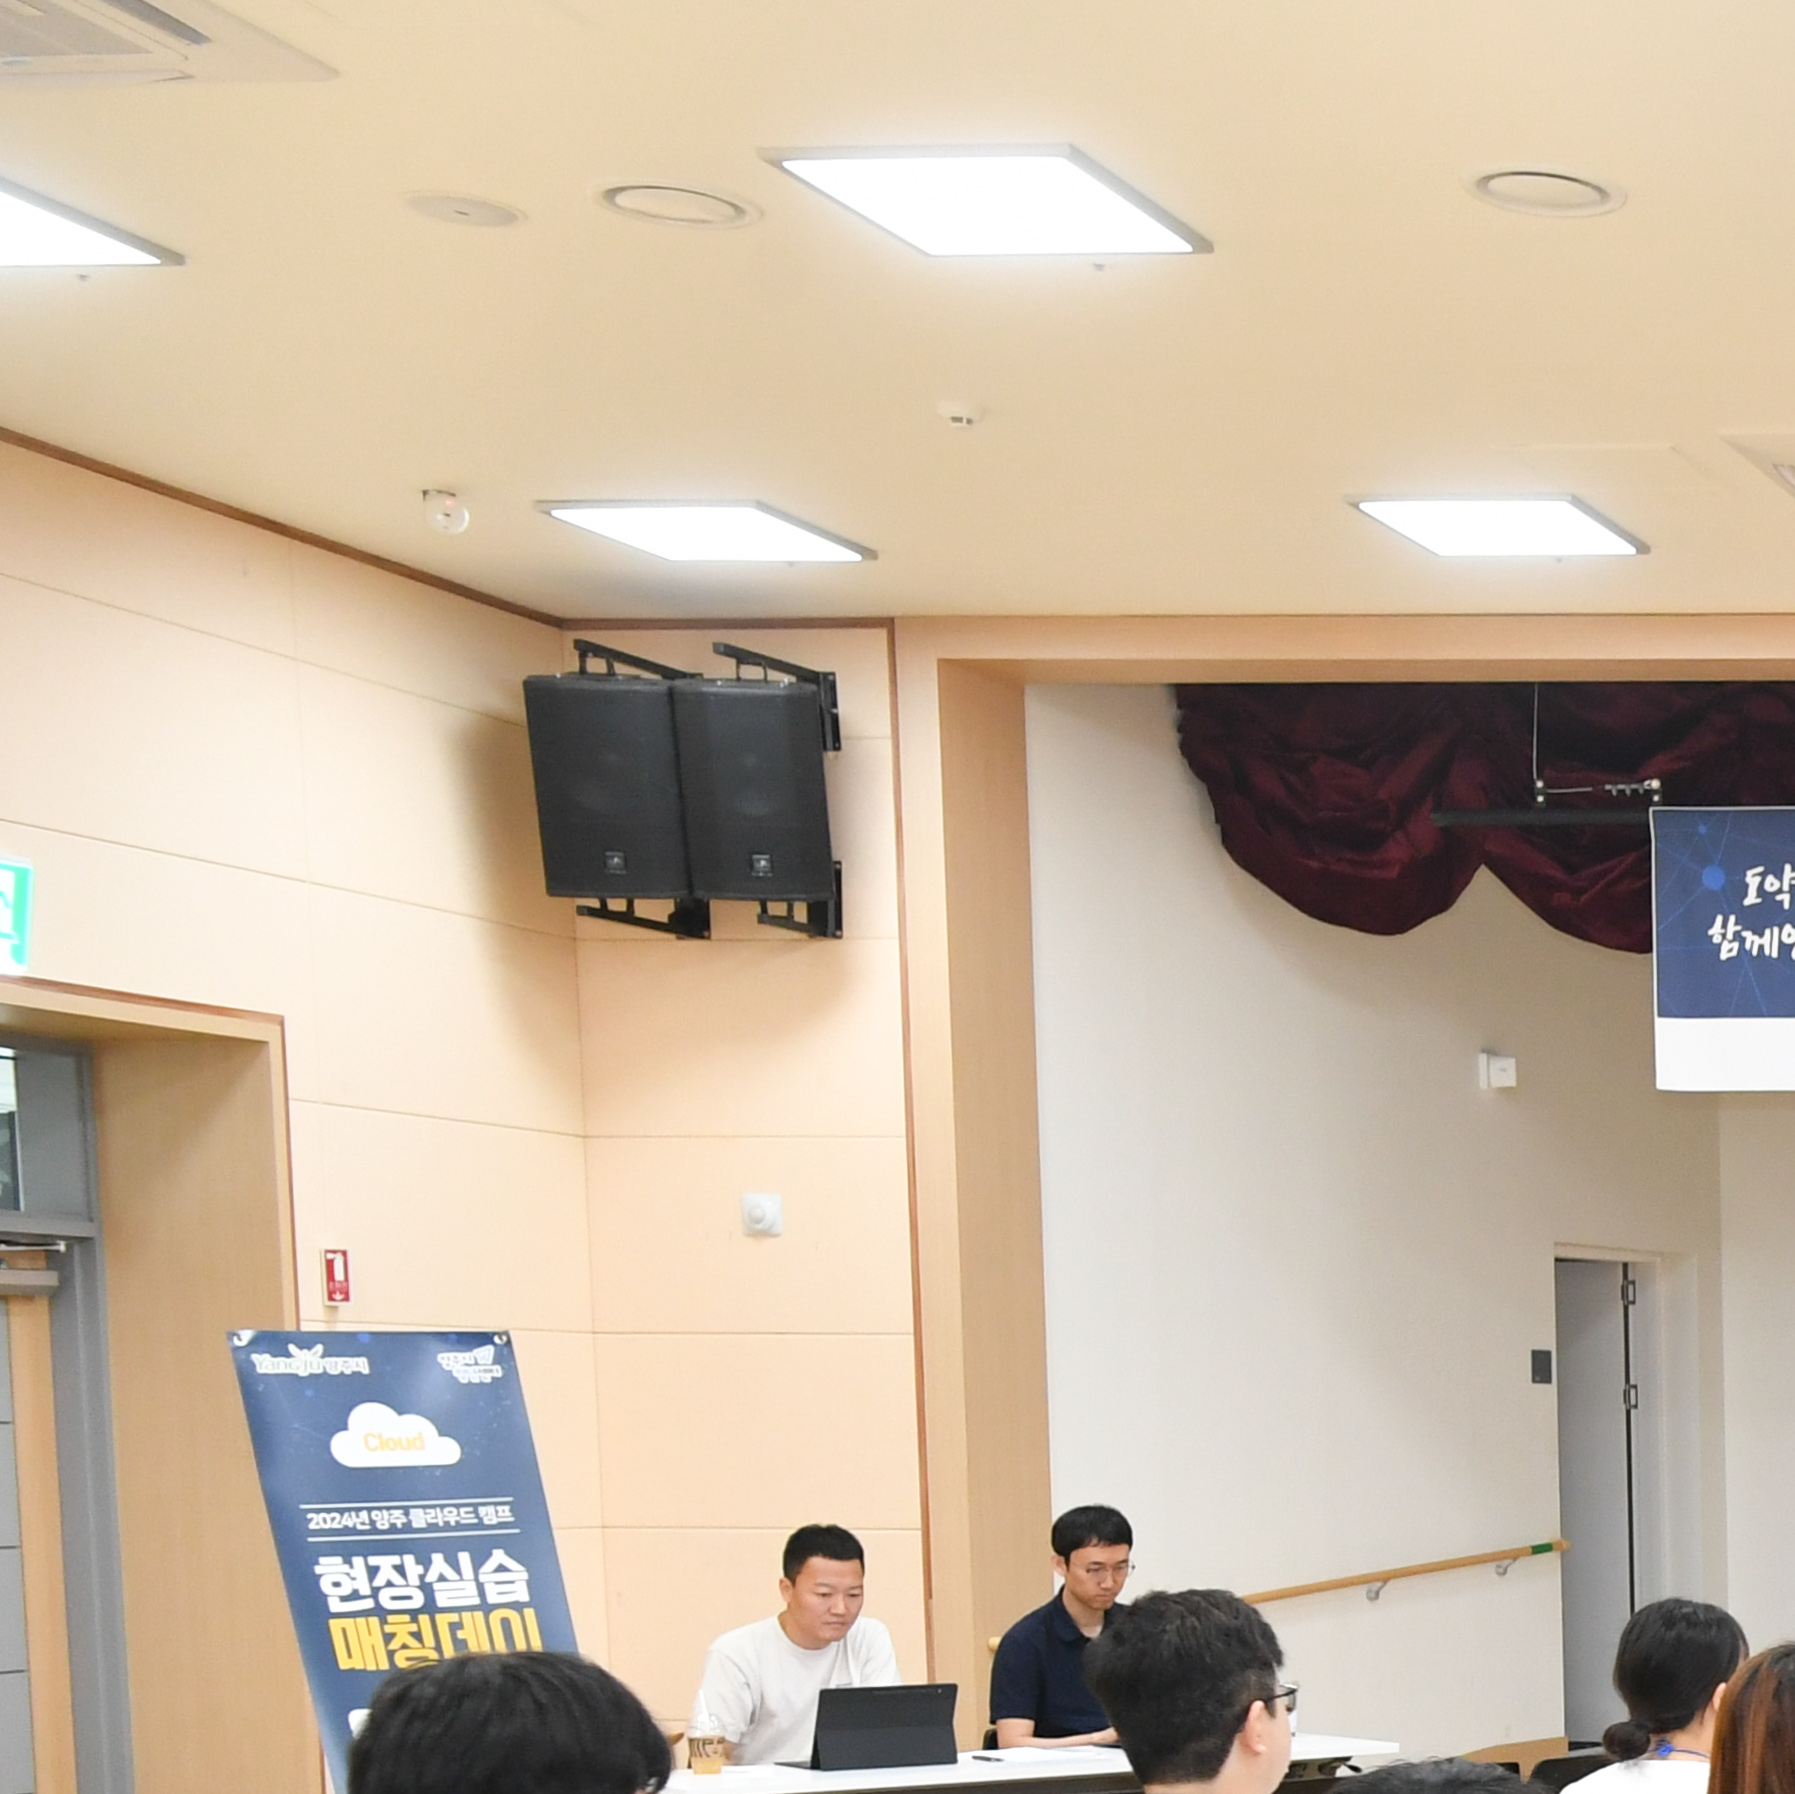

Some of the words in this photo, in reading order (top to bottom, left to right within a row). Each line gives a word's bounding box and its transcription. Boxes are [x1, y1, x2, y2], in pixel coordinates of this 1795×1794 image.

[363, 1432, 426, 1453] Cloud
[306, 1510, 372, 1531] 2024년
[371, 1508, 408, 1530] 양주
[408, 1507, 478, 1528] 클라우드
[478, 1504, 515, 1526] 캠프
[313, 1548, 531, 1614] 현장실습
[327, 1607, 544, 1671] 매칭데이
